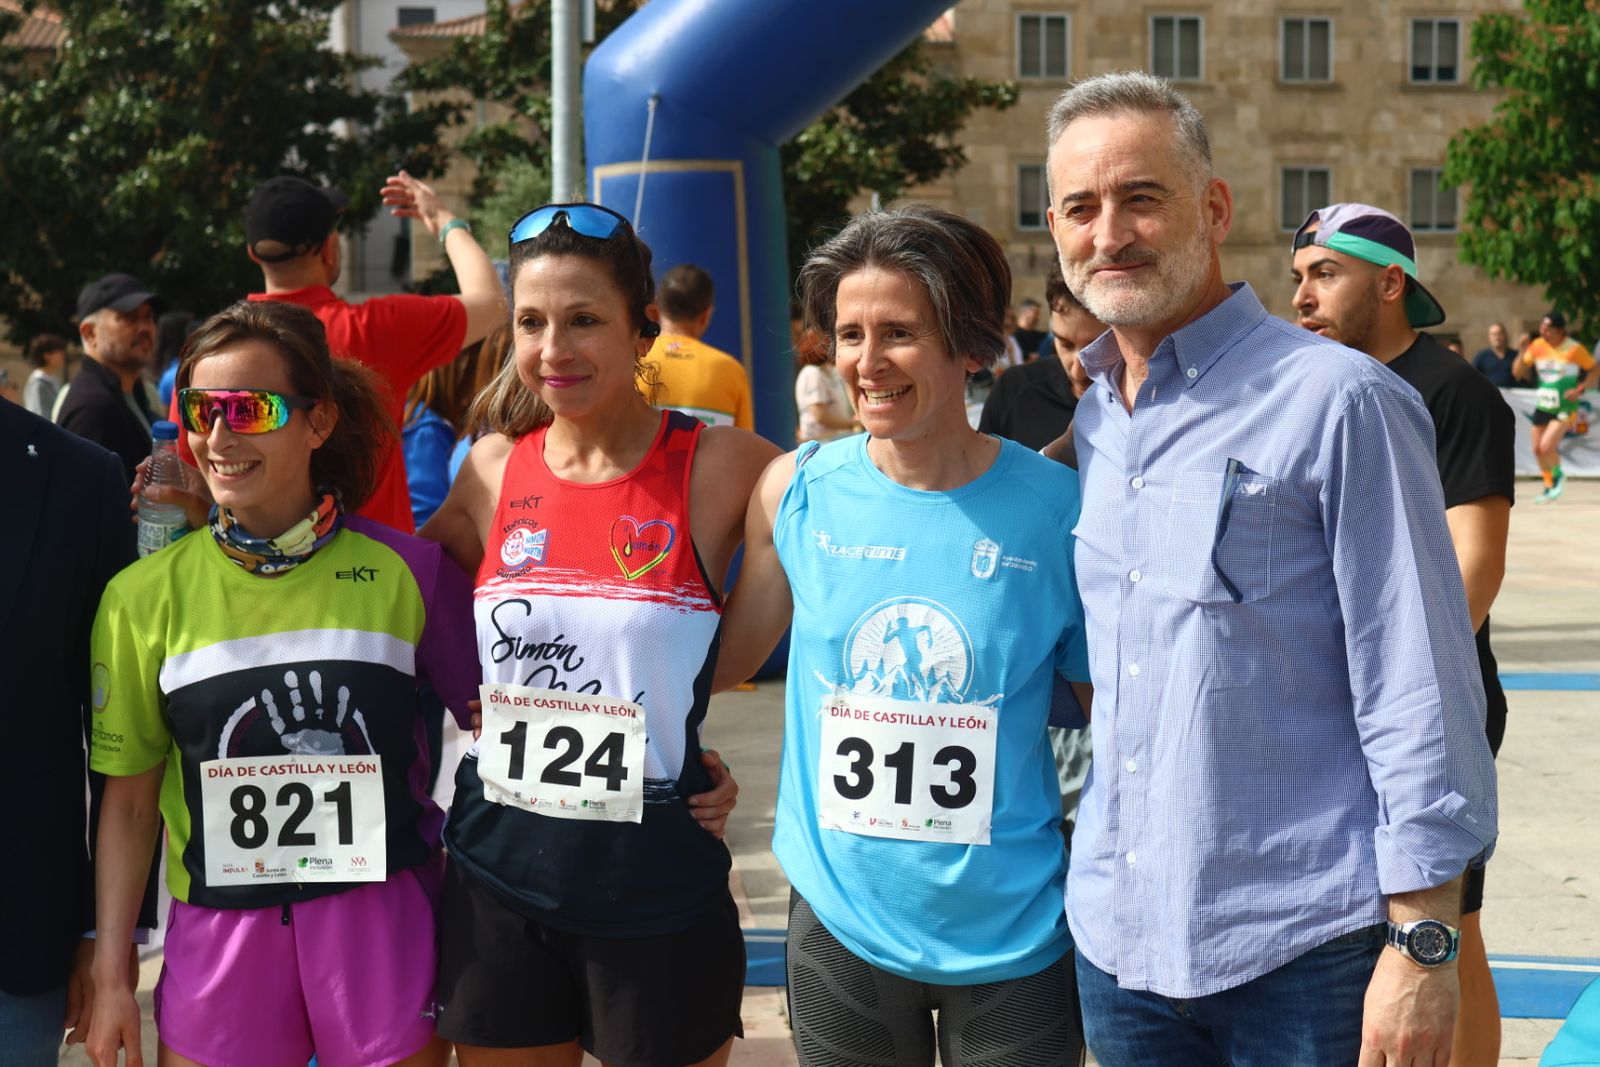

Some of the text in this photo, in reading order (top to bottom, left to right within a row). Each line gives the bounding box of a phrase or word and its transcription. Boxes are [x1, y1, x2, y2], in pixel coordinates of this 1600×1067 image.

[510, 495, 543, 510] EKT
[336, 566, 379, 582] EKT
[491, 598, 584, 672] Simón
[490, 692, 636, 718] DÍA DE CASTILLA Y LEÓN
[831, 705, 987, 730] DÍA DE CASTILLA Y LEÓN
[501, 720, 628, 791] 124
[208, 761, 377, 778] DÍA DE CASTILLA Y LEÓN
[833, 737, 977, 809] 313
[229, 781, 353, 849] 821
[310, 857, 333, 865] Plena
